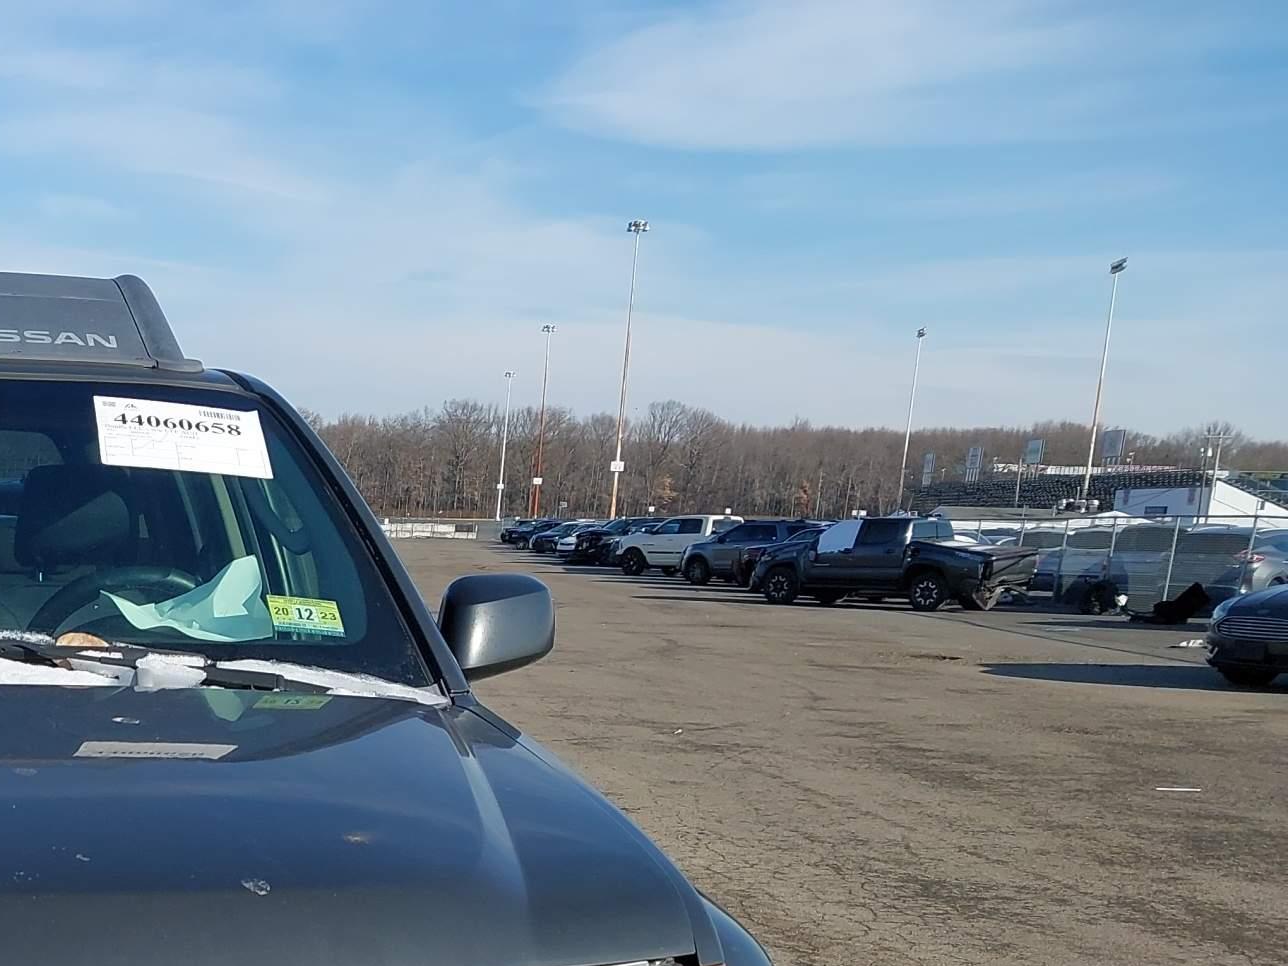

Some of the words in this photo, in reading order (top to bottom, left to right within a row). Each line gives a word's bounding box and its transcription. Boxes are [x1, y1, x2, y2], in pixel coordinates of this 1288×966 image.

[113, 412, 242, 437] 44060658
[273, 606, 289, 616] 20
[295, 607, 314, 621] 12
[319, 611, 337, 621] 23
